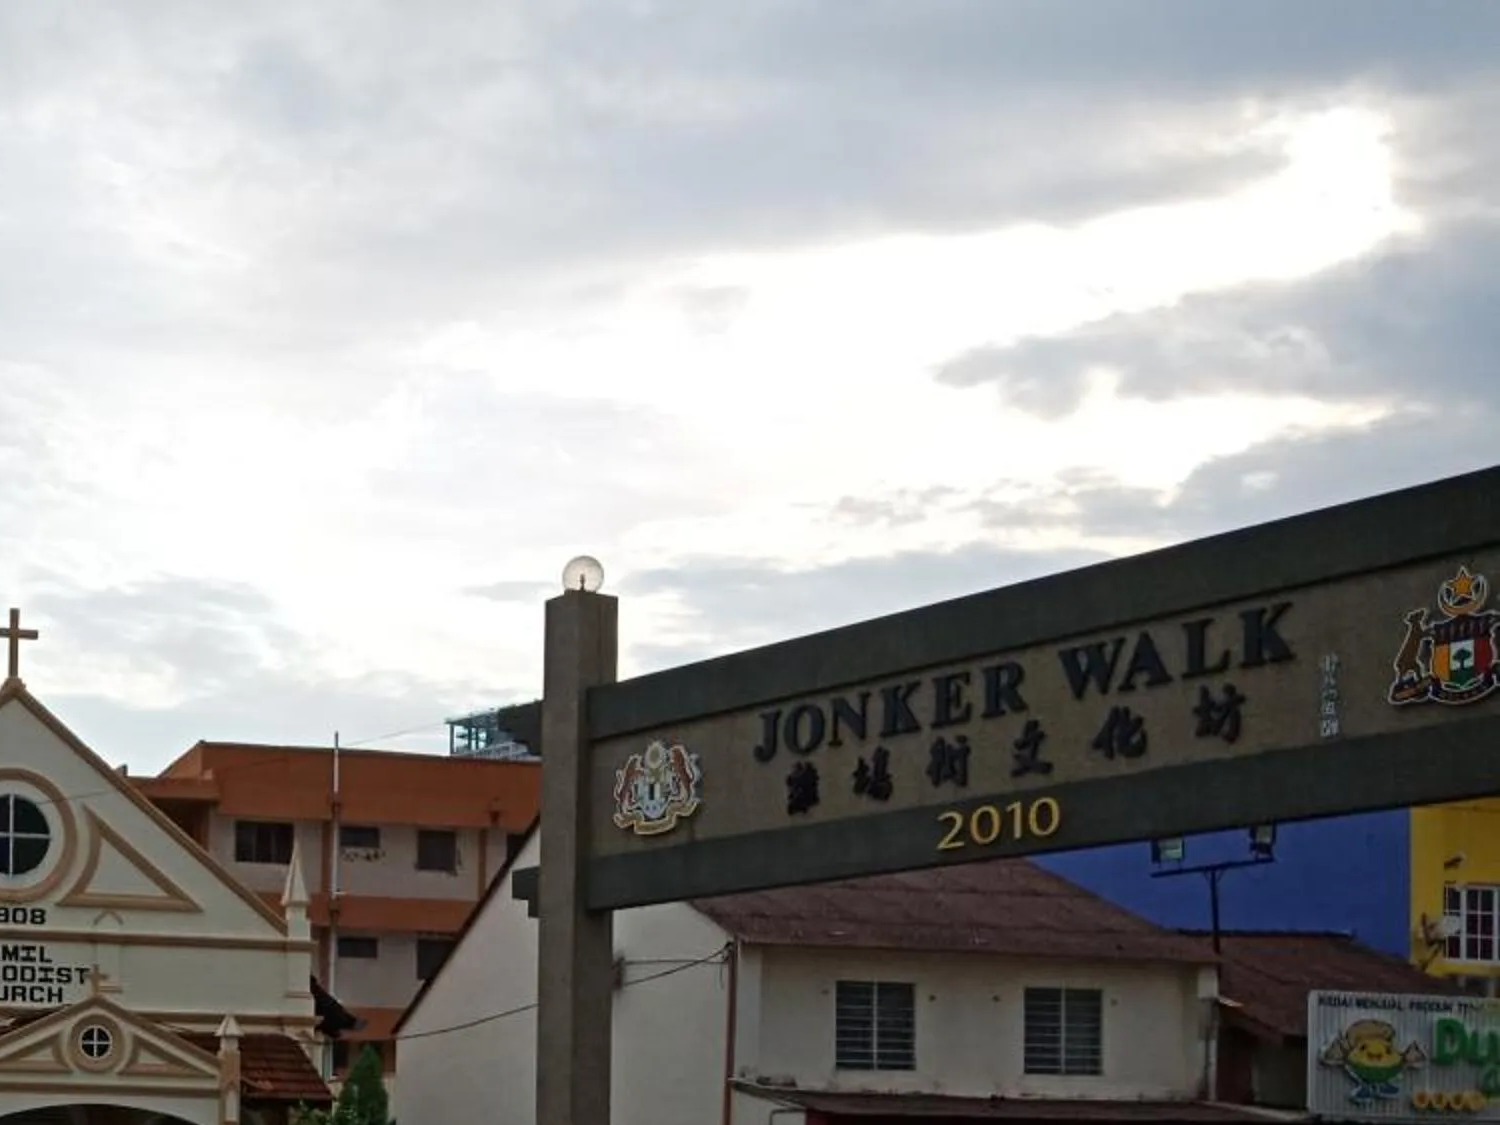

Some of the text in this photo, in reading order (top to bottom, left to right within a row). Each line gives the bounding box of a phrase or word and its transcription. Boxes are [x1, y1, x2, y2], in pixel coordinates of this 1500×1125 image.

[753, 661, 1029, 763] JONKER
[1057, 602, 1295, 701] WALK
[936, 797, 1061, 851] 2010
